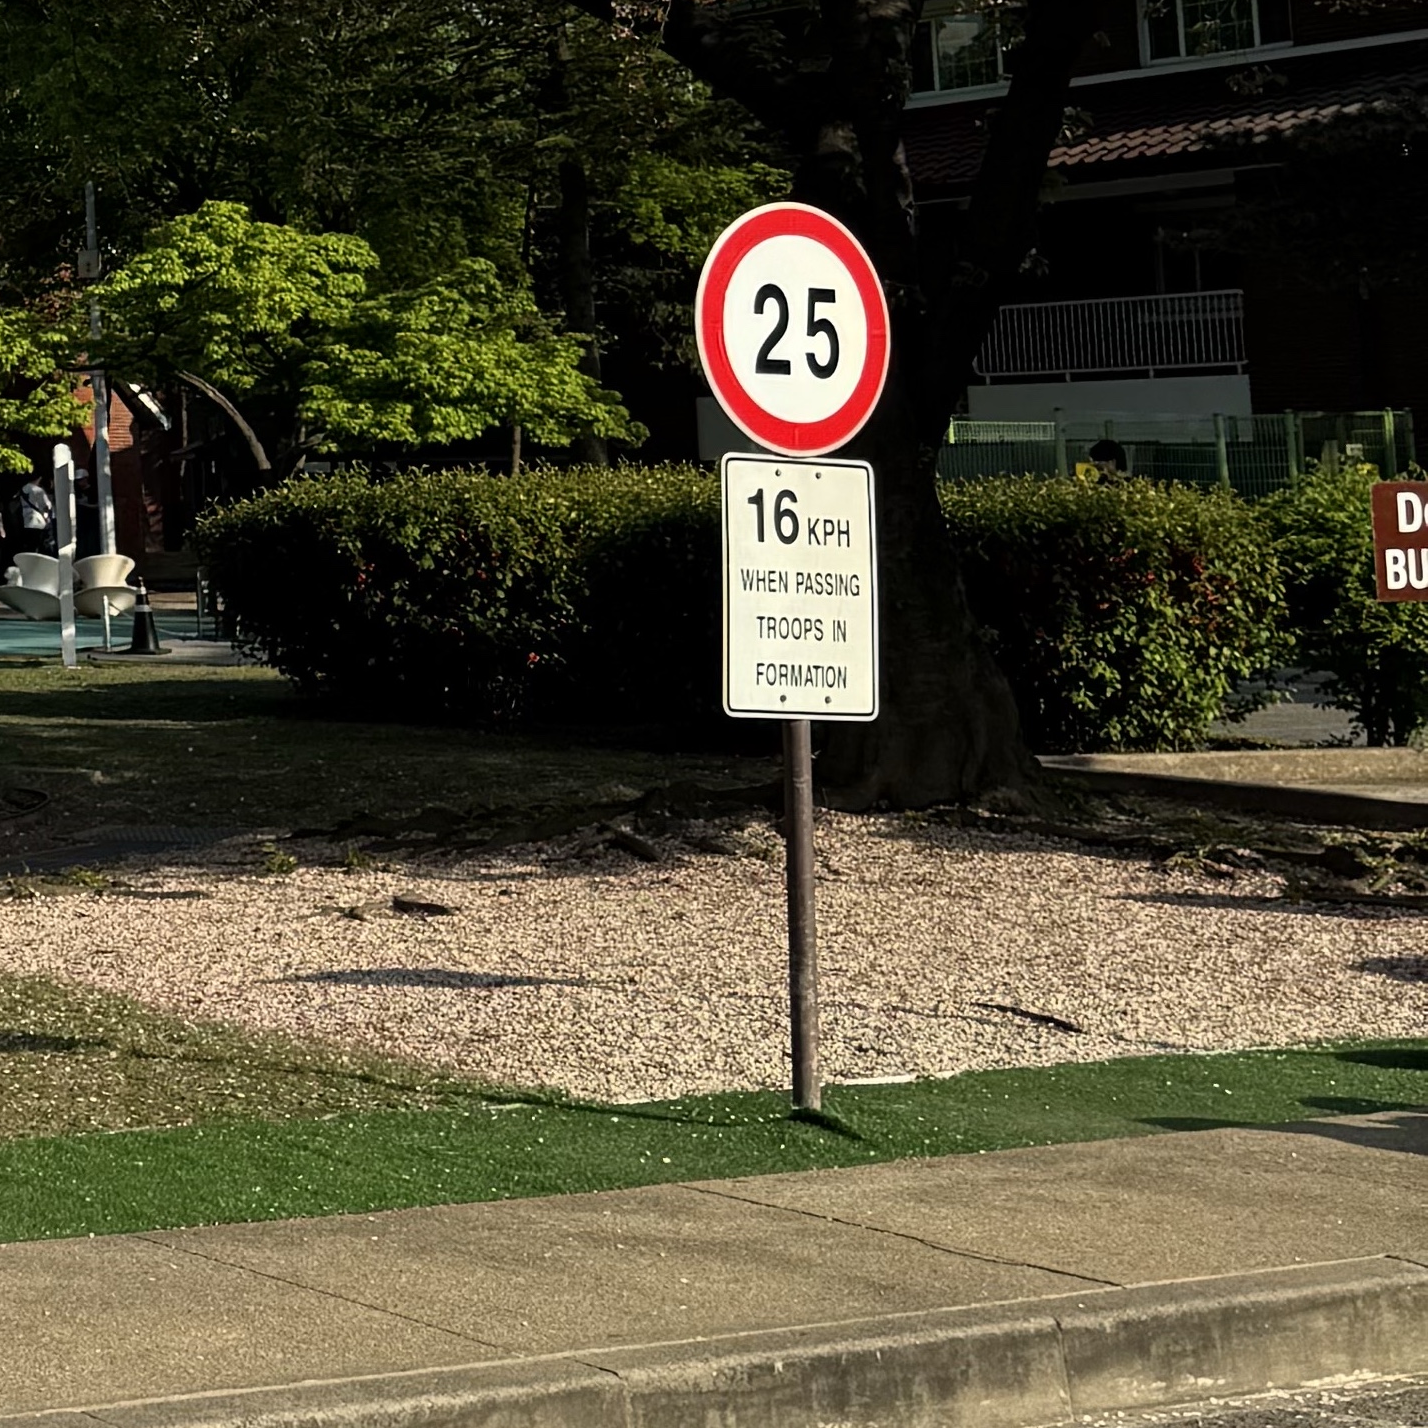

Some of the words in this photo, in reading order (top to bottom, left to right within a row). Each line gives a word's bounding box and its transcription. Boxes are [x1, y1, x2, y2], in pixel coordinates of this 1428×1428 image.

[753, 283, 840, 379] 25
[747, 488, 799, 545] 16
[808, 517, 850, 548] KPH
[1397, 492, 1428, 533] D
[740, 568, 788, 594] WHEN
[796, 572, 860, 597] PASSING
[756, 616, 824, 641] TROOPS
[832, 619, 847, 643] IN
[756, 663, 847, 689] FORMATION
